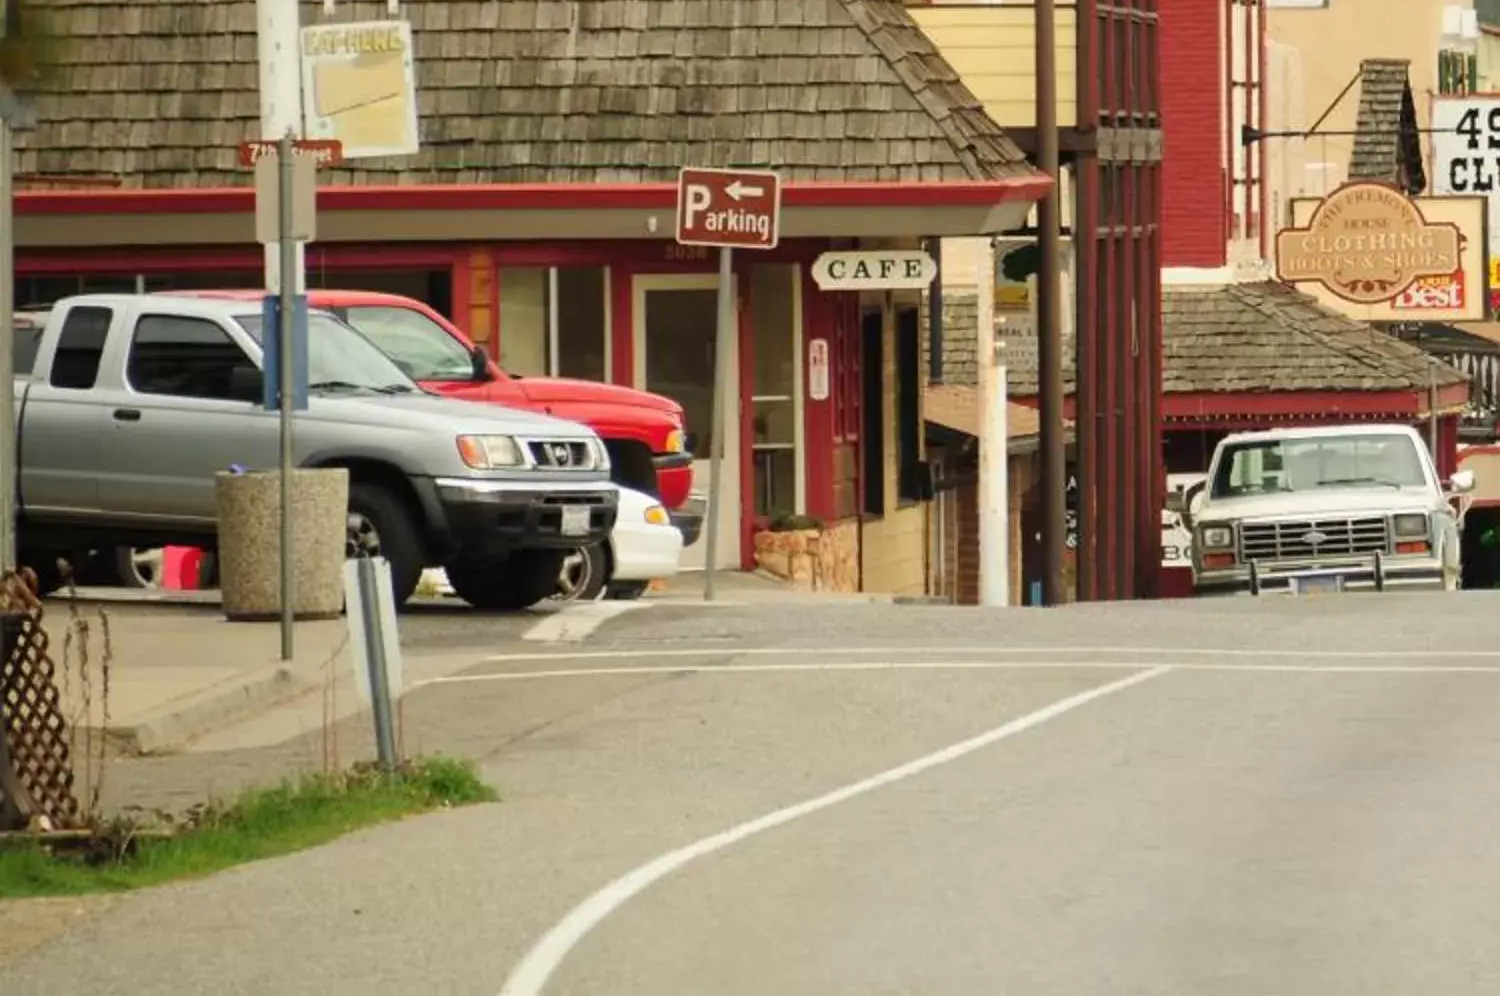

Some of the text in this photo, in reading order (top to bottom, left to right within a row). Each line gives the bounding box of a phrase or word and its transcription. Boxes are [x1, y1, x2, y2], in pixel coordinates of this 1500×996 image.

[685, 184, 769, 242] Parking
[1301, 231, 1434, 253] CLOTHING
[827, 259, 923, 281] CAFE
[1289, 255, 1357, 271] BOOTS
[1386, 252, 1450, 269] SHOES
